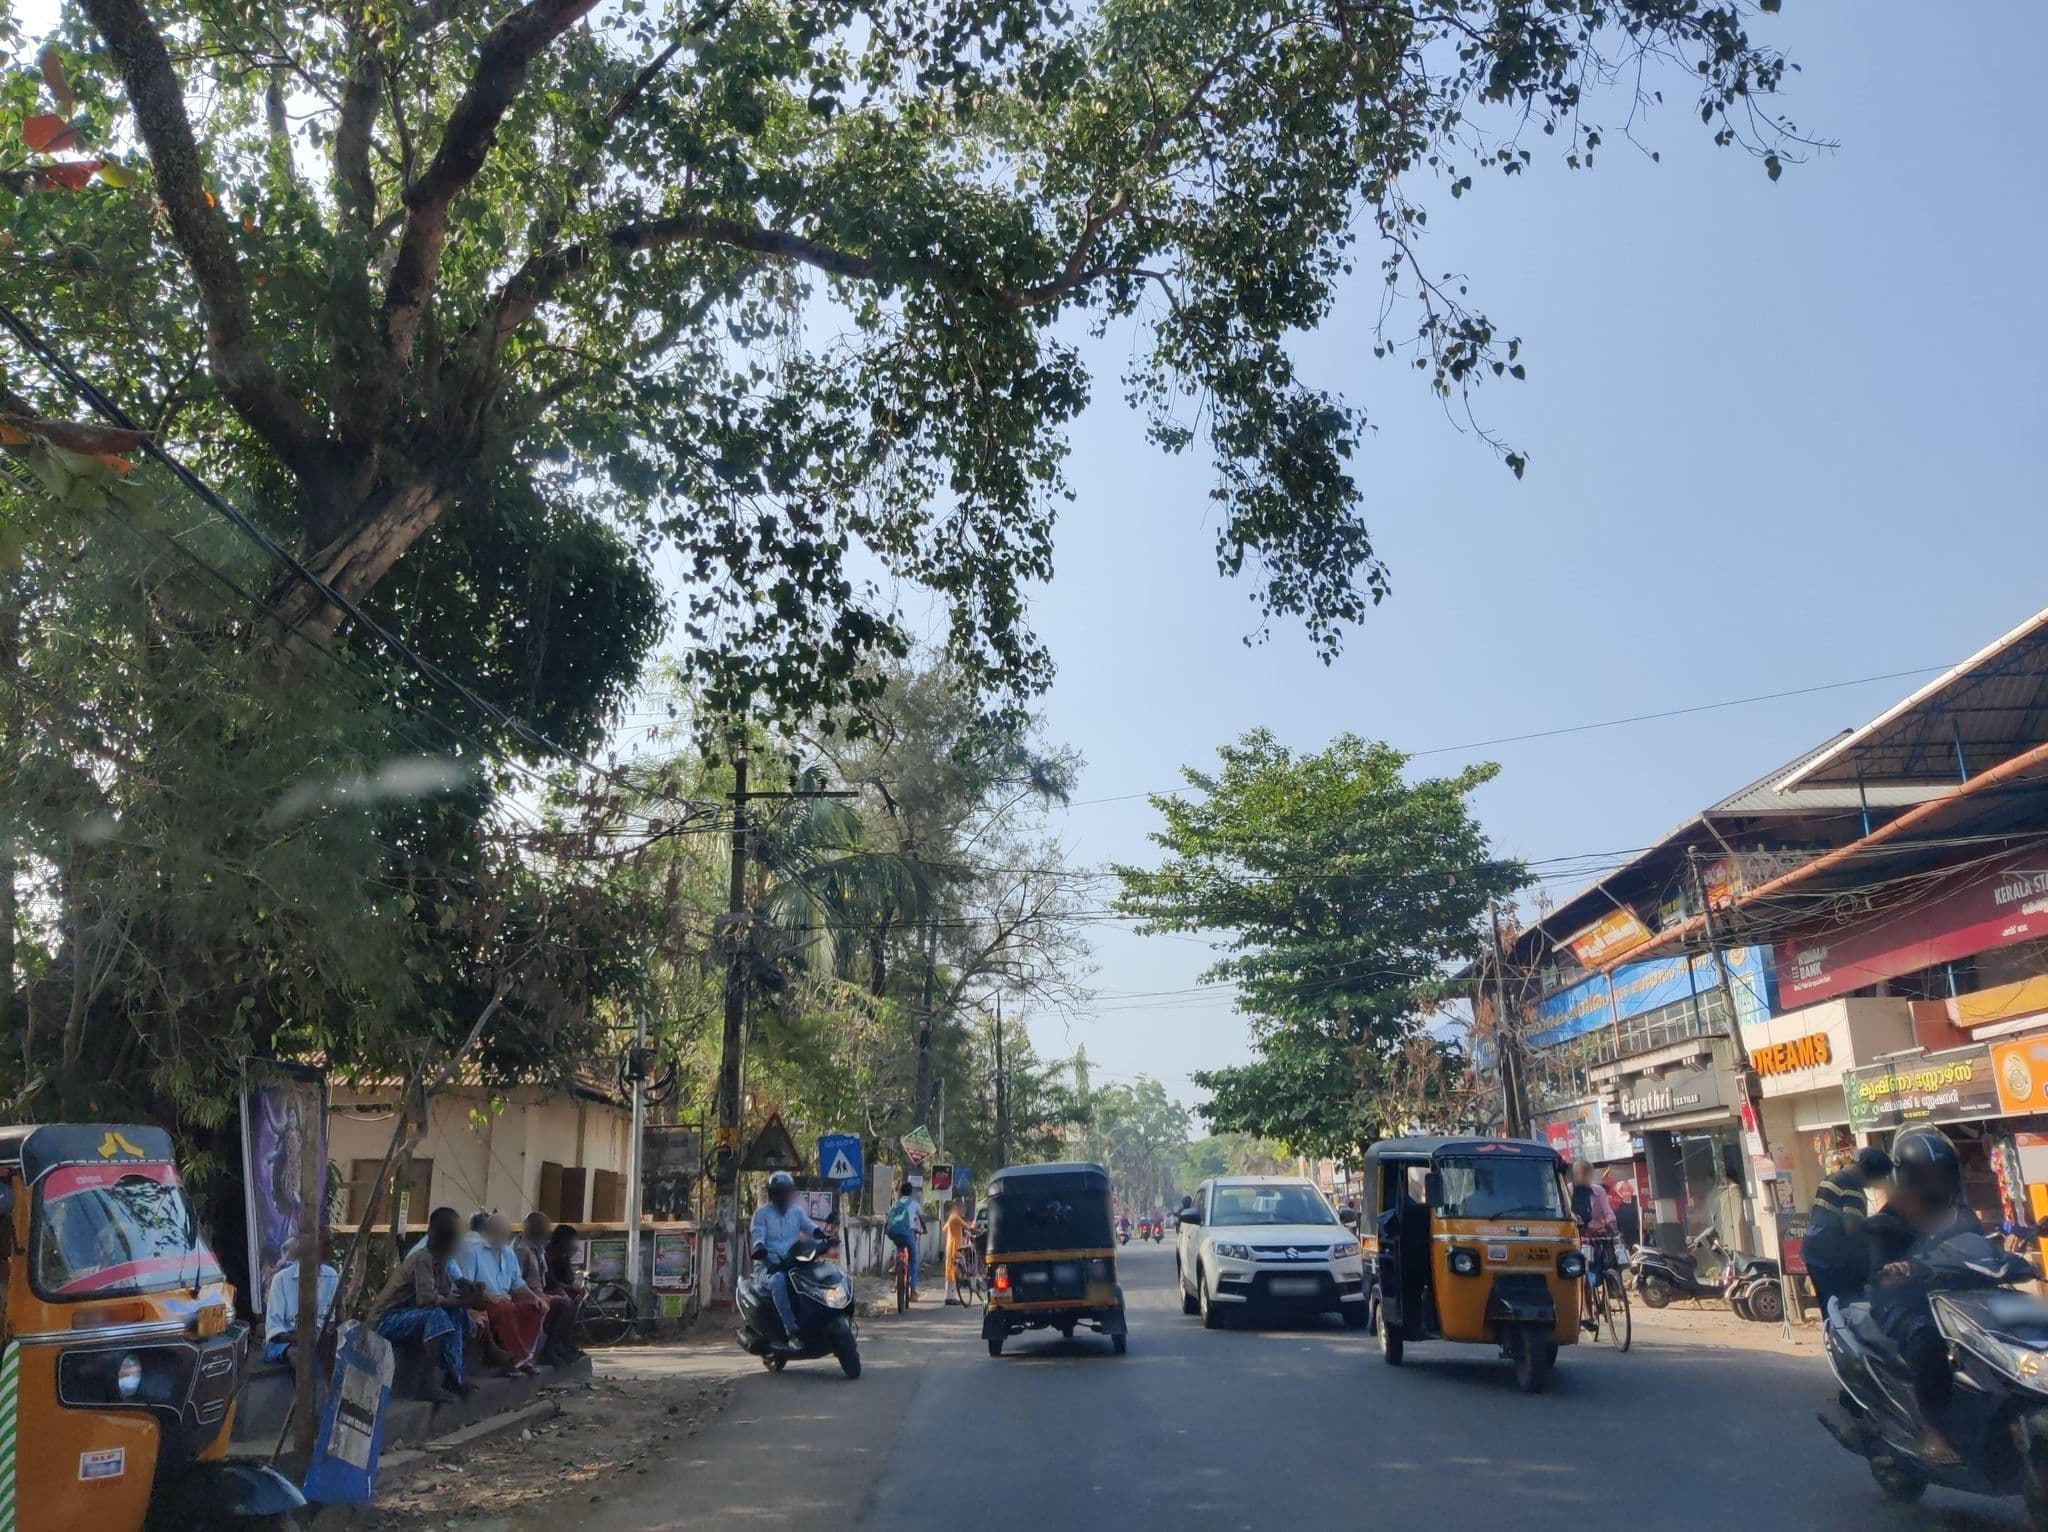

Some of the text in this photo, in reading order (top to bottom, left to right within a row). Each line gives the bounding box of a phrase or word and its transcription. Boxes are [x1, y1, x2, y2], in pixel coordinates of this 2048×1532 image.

[1994, 882, 2033, 905] KERALA
[1800, 961, 1822, 980] BANK
[1751, 1032, 1829, 1077] DREAMS
[1622, 1087, 1699, 1119] Gayathri TEXTILES
